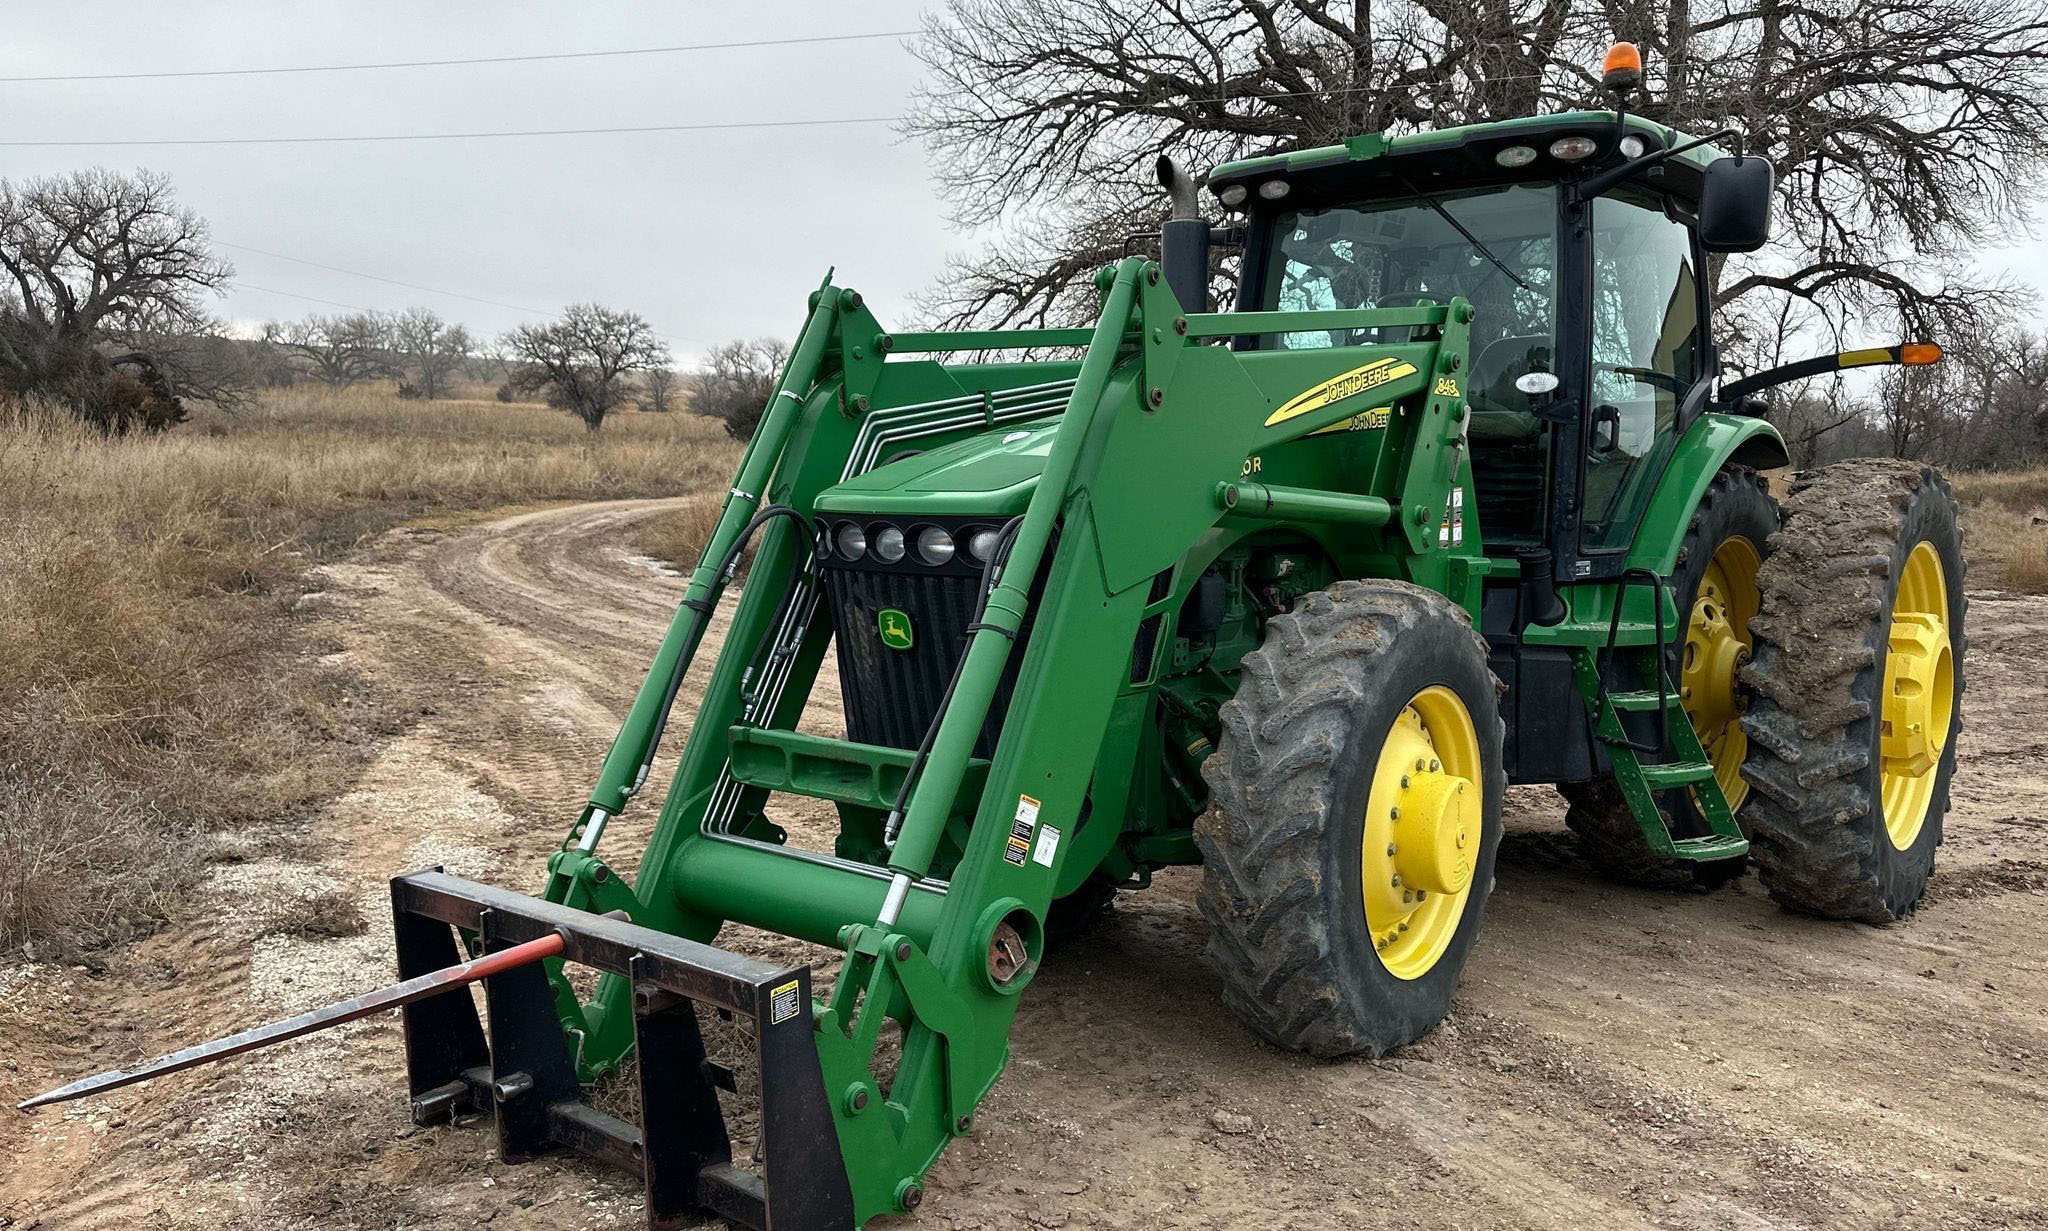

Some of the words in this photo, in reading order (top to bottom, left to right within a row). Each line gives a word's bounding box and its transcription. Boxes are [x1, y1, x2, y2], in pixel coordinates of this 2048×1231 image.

[1324, 377, 1354, 402] JOHN
[1352, 365, 1390, 392] DEERE
[1437, 377, 1458, 395] 843
[1349, 415, 1371, 431] JOHN
